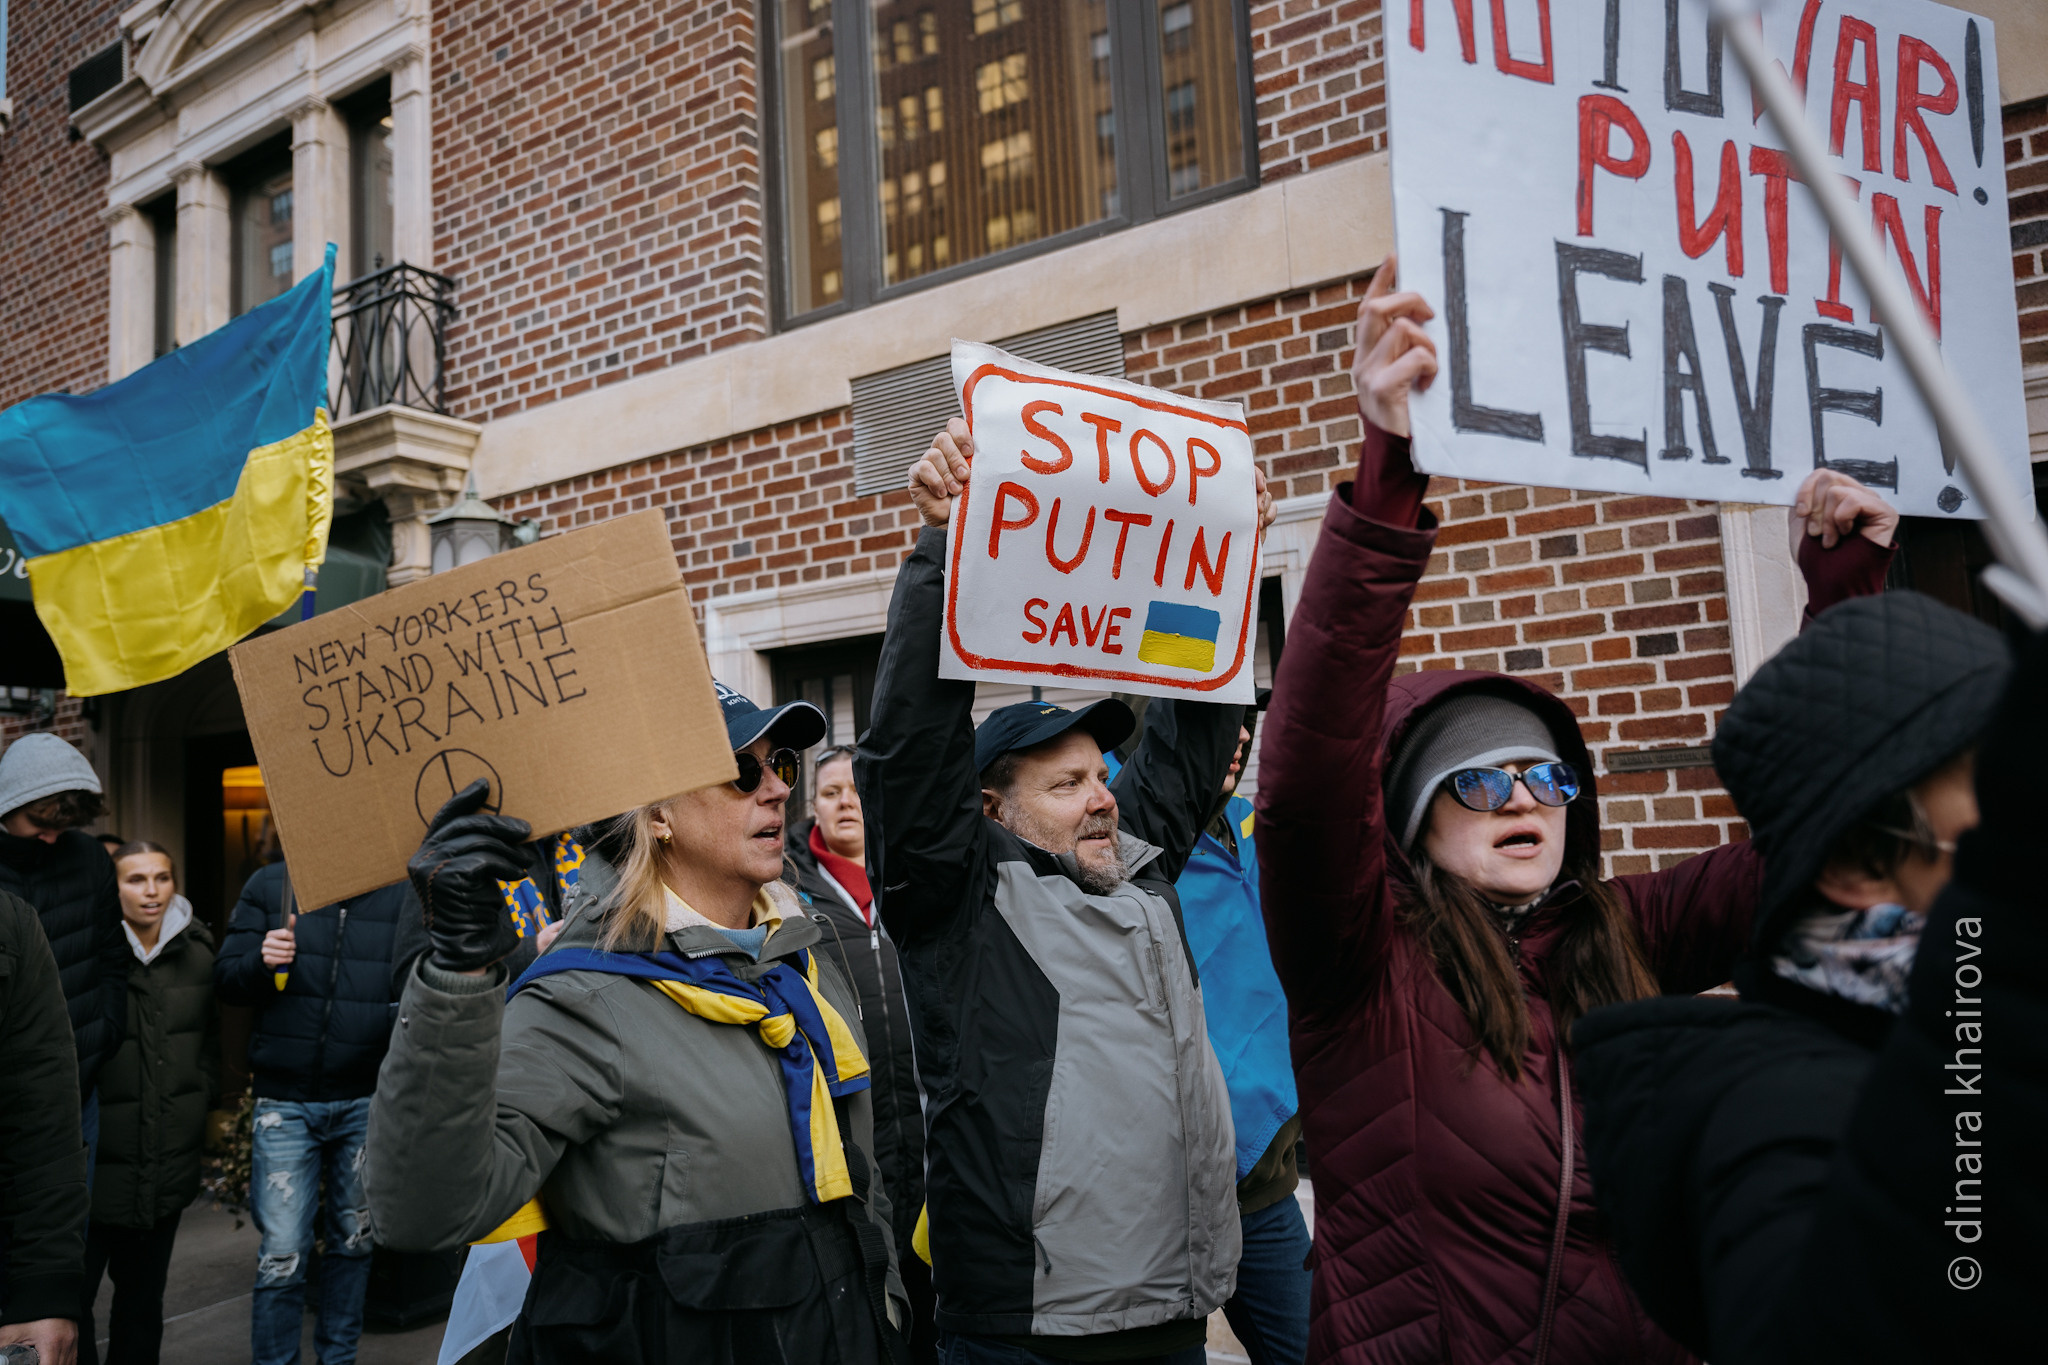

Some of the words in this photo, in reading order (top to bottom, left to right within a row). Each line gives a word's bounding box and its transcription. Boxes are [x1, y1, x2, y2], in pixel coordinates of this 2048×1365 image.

[1577, 95, 1944, 344] PUTIN
[1021, 400, 1221, 506] STOP
[988, 481, 1232, 597] PUTIN
[293, 632, 366, 683] NEW
[376, 573, 548, 651] YORKERS
[303, 653, 433, 731] STAND
[444, 606, 568, 676] WITH
[1022, 598, 1131, 655] SAVE
[312, 648, 587, 777] UKRAINE
